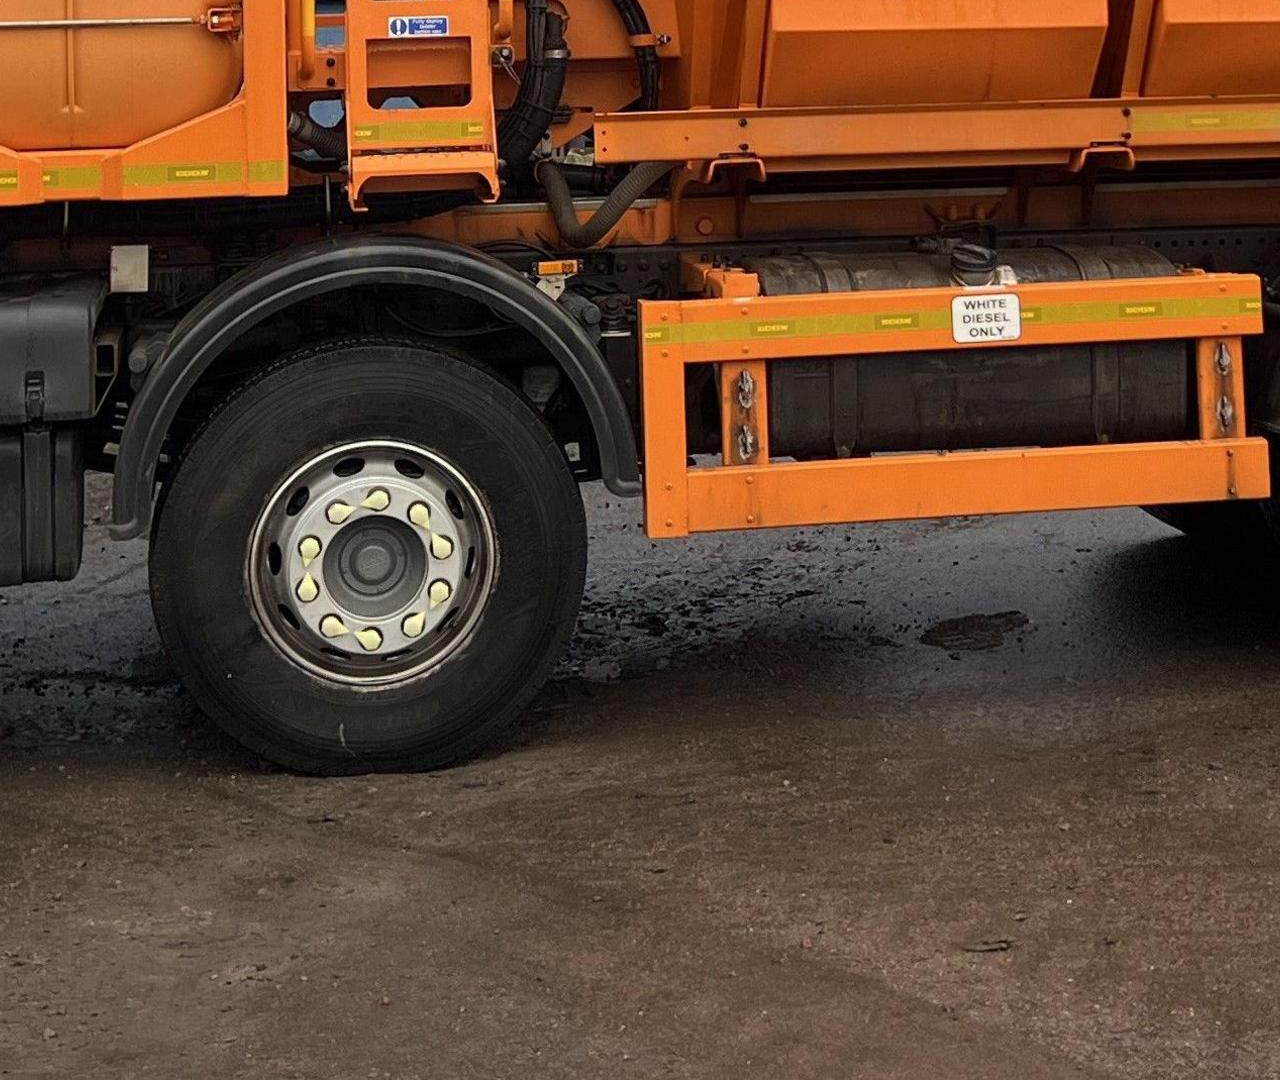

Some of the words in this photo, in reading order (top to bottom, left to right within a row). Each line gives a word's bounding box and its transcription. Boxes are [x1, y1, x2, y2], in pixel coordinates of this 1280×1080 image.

[963, 298, 1008, 310] WHITE
[962, 312, 1011, 324] DIESEL
[969, 326, 1005, 338] ONLY
